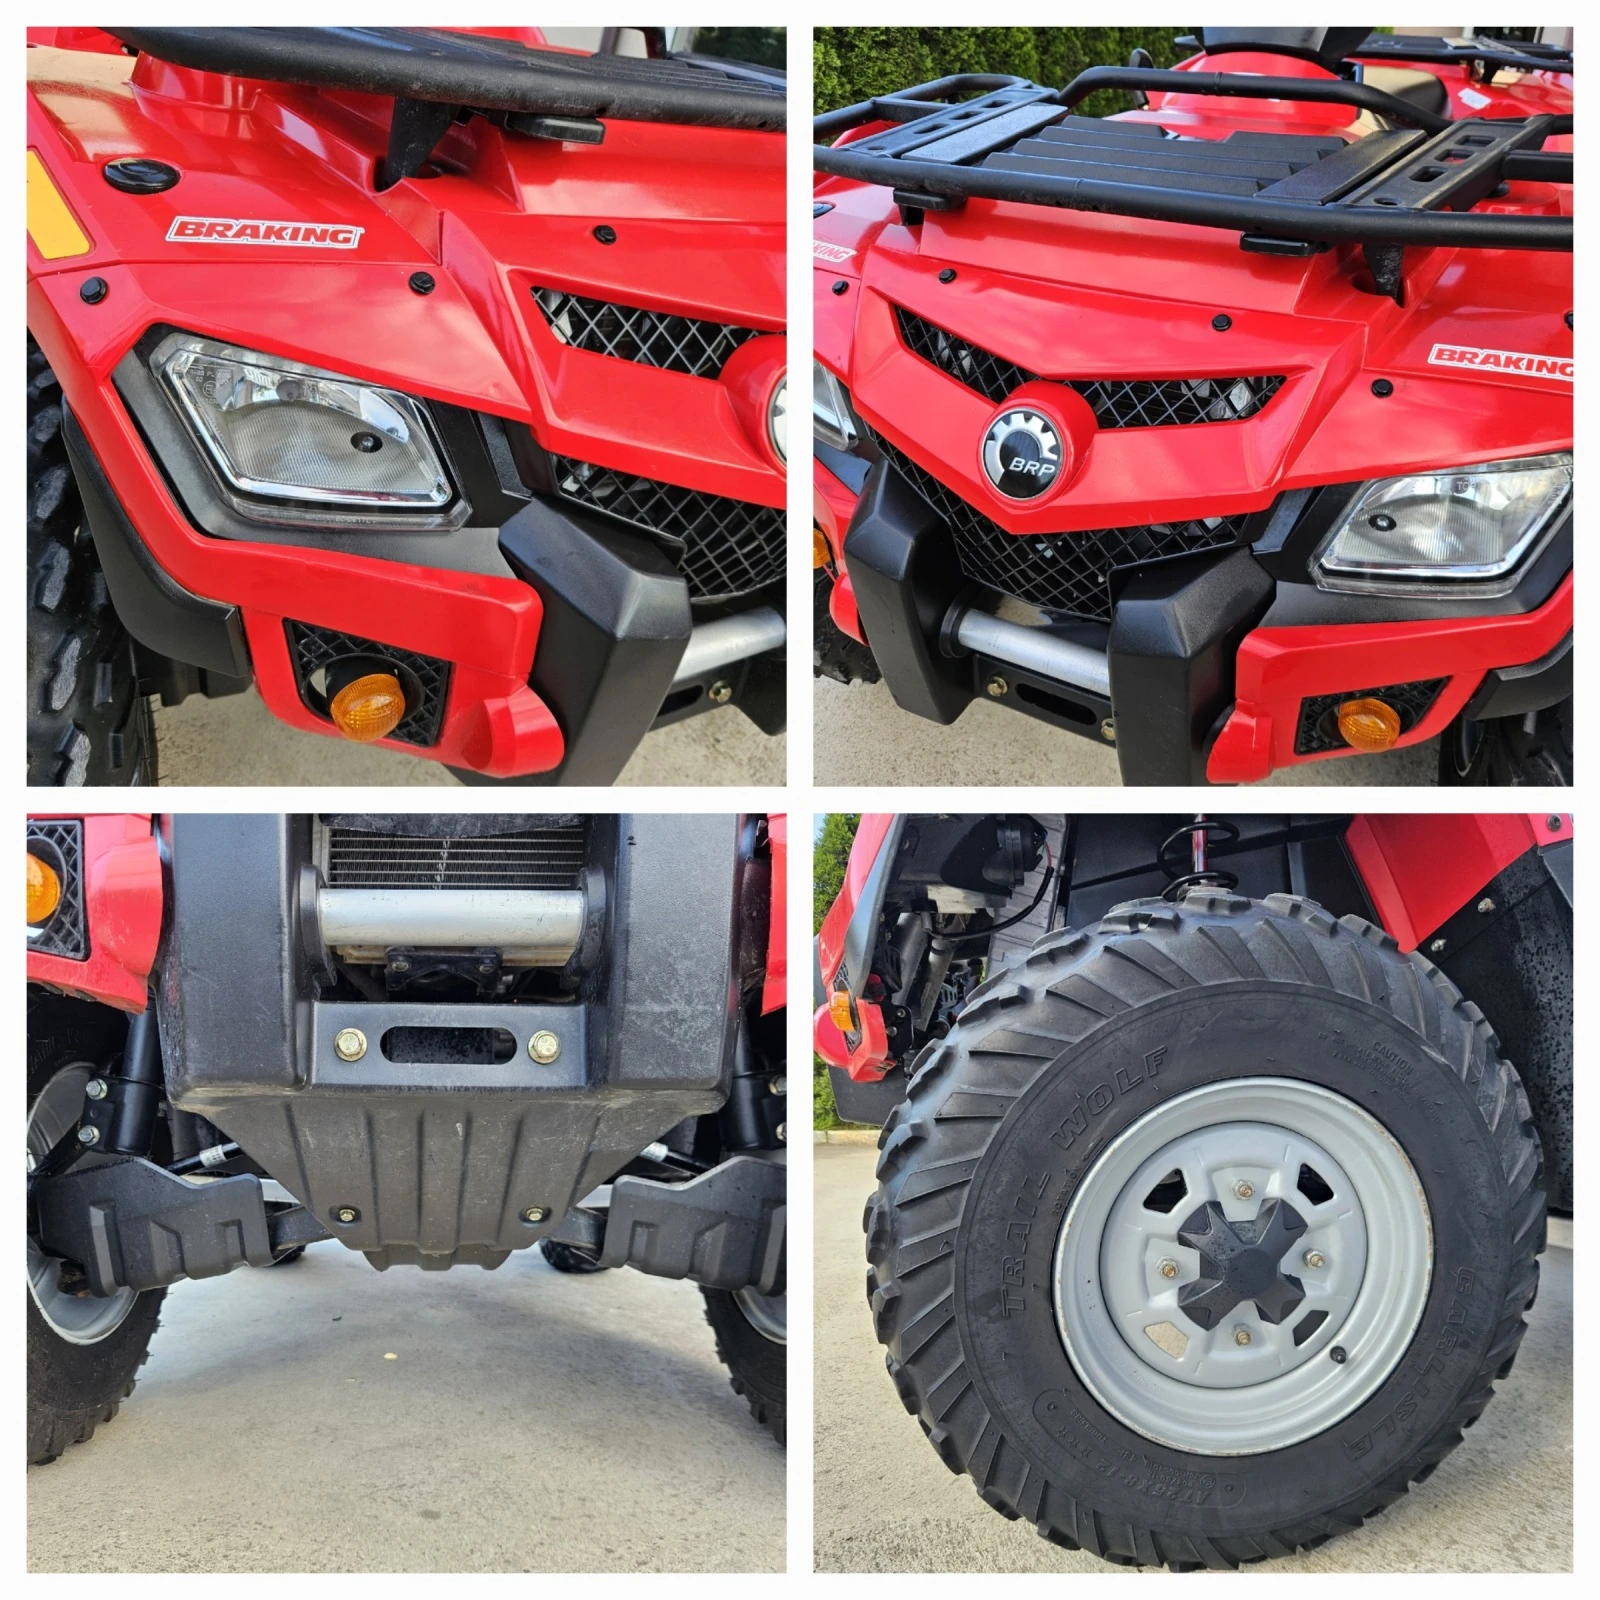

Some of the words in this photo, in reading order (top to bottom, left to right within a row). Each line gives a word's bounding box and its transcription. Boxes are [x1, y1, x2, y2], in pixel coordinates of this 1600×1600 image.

[173, 220, 353, 244] BRAKING
[1434, 347, 1573, 377] BRAKING
[1009, 457, 1055, 476] BRP
[1372, 1041, 1414, 1076] CAUTION
[1001, 1170, 1051, 1318] TRAIL
[1049, 1046, 1170, 1151] WOLF
[1051, 1164, 1082, 1216] ROTATION
[1345, 1267, 1475, 1462] CARLISLE
